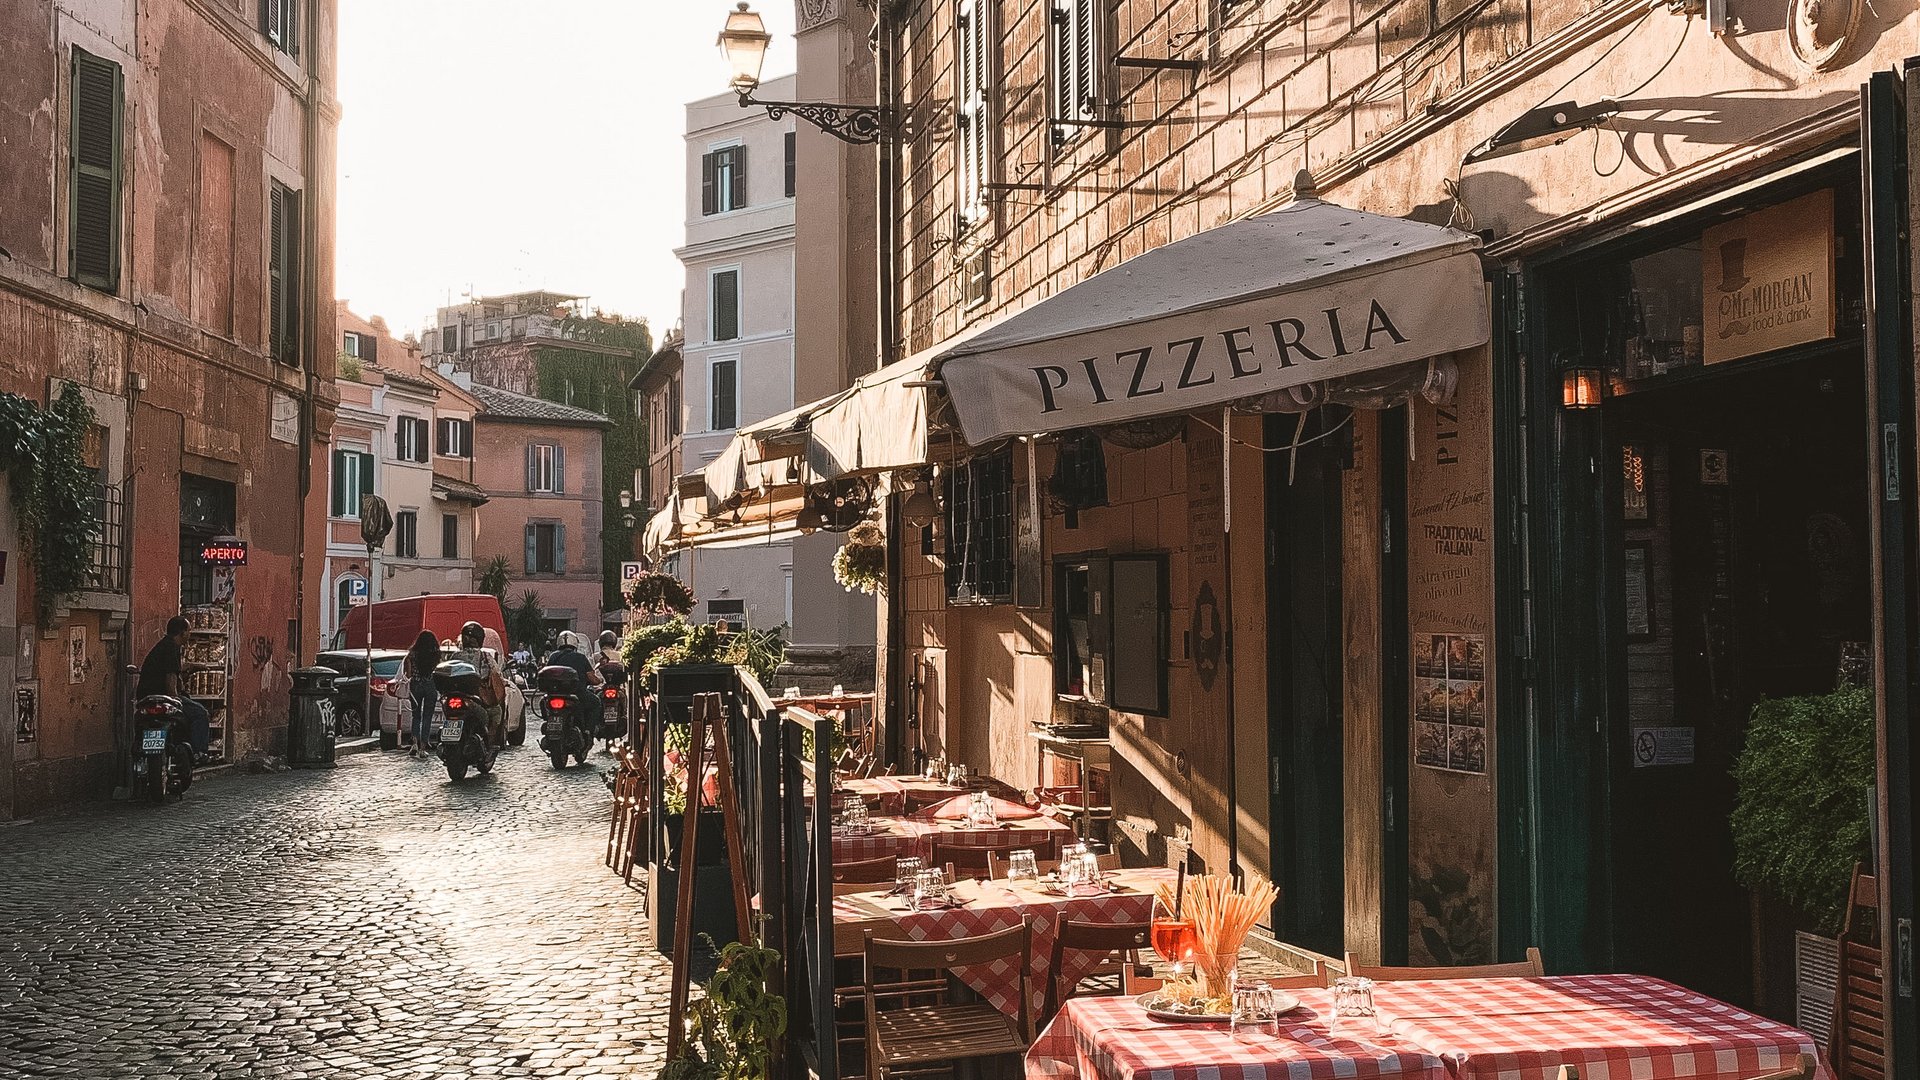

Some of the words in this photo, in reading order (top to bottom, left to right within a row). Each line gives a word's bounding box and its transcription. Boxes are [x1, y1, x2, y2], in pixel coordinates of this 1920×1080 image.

[1752, 313, 1774, 332] food
[1776, 309, 1785, 325] &
[1787, 304, 1812, 323] drink
[1028, 299, 1411, 414] PIZZERIA
[1436, 391, 1459, 466] PIZ
[1424, 525, 1486, 542] TRADITIONAL
[203, 548, 244, 560] APERTO
[1435, 540, 1473, 556] ITALIAN
[626, 565, 636, 578] P
[1415, 570, 1440, 584] extra
[1442, 565, 1470, 580] virgin
[353, 580, 365, 595] P
[1425, 585, 1448, 599] olive
[1450, 582, 1462, 596] oil
